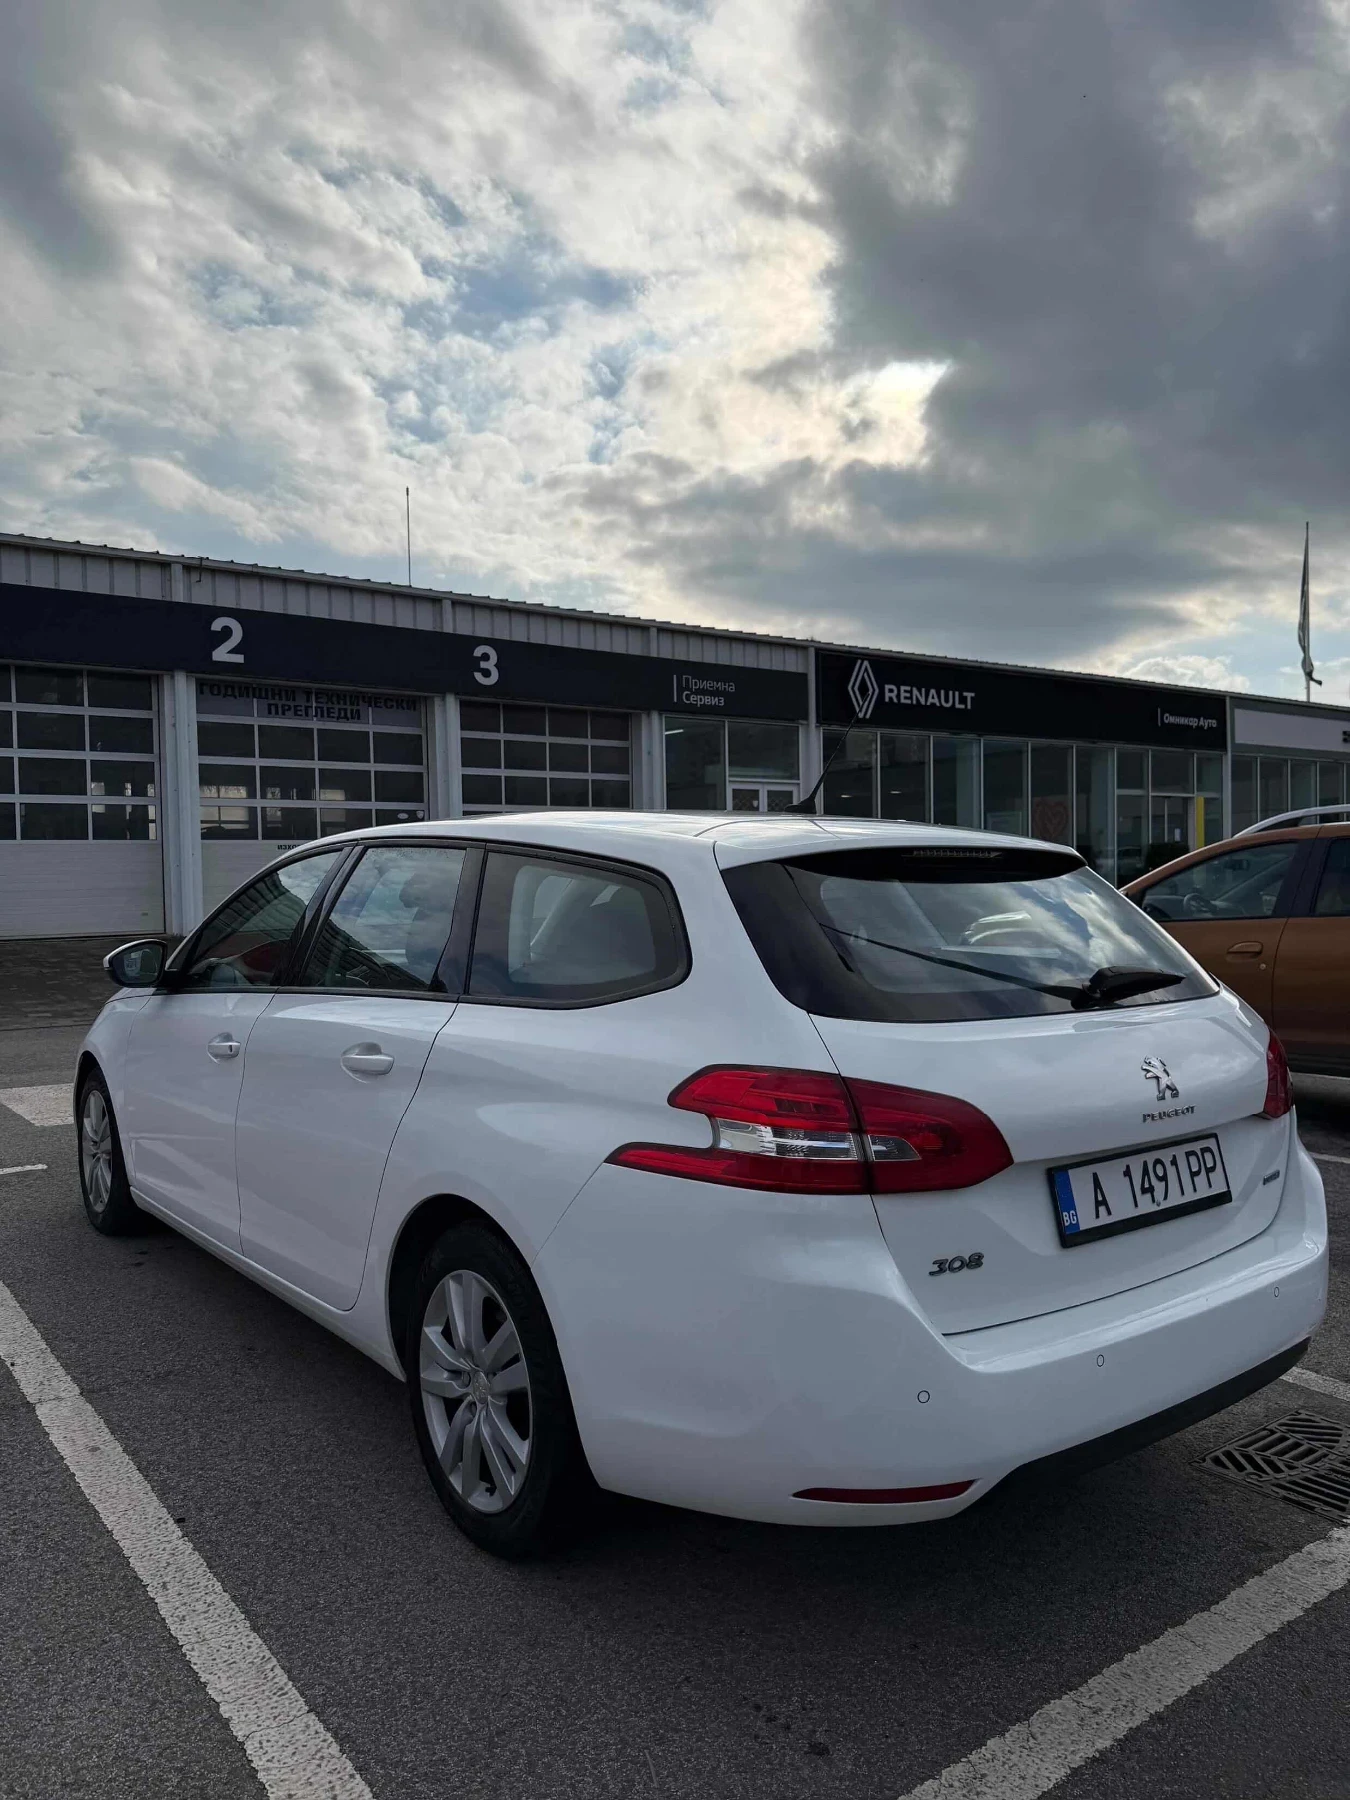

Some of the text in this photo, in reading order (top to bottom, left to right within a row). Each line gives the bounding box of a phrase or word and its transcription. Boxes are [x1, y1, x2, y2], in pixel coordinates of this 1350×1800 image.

[211, 616, 244, 664] 2
[473, 645, 499, 686] 3
[682, 675, 736, 692] Приемна
[199, 682, 418, 713] ГОДИШНИ ТЕХНИЧЕСКИ
[682, 691, 725, 707] Сервиз
[884, 684, 976, 709] RENAULT
[267, 703, 362, 721] ПРЕГЛЕДИ
[1163, 713, 1217, 730] Омникар Ауто
[1142, 1104, 1196, 1123] PEUGEOT
[1062, 1211, 1078, 1226] BG
[929, 1252, 984, 1276] 308
